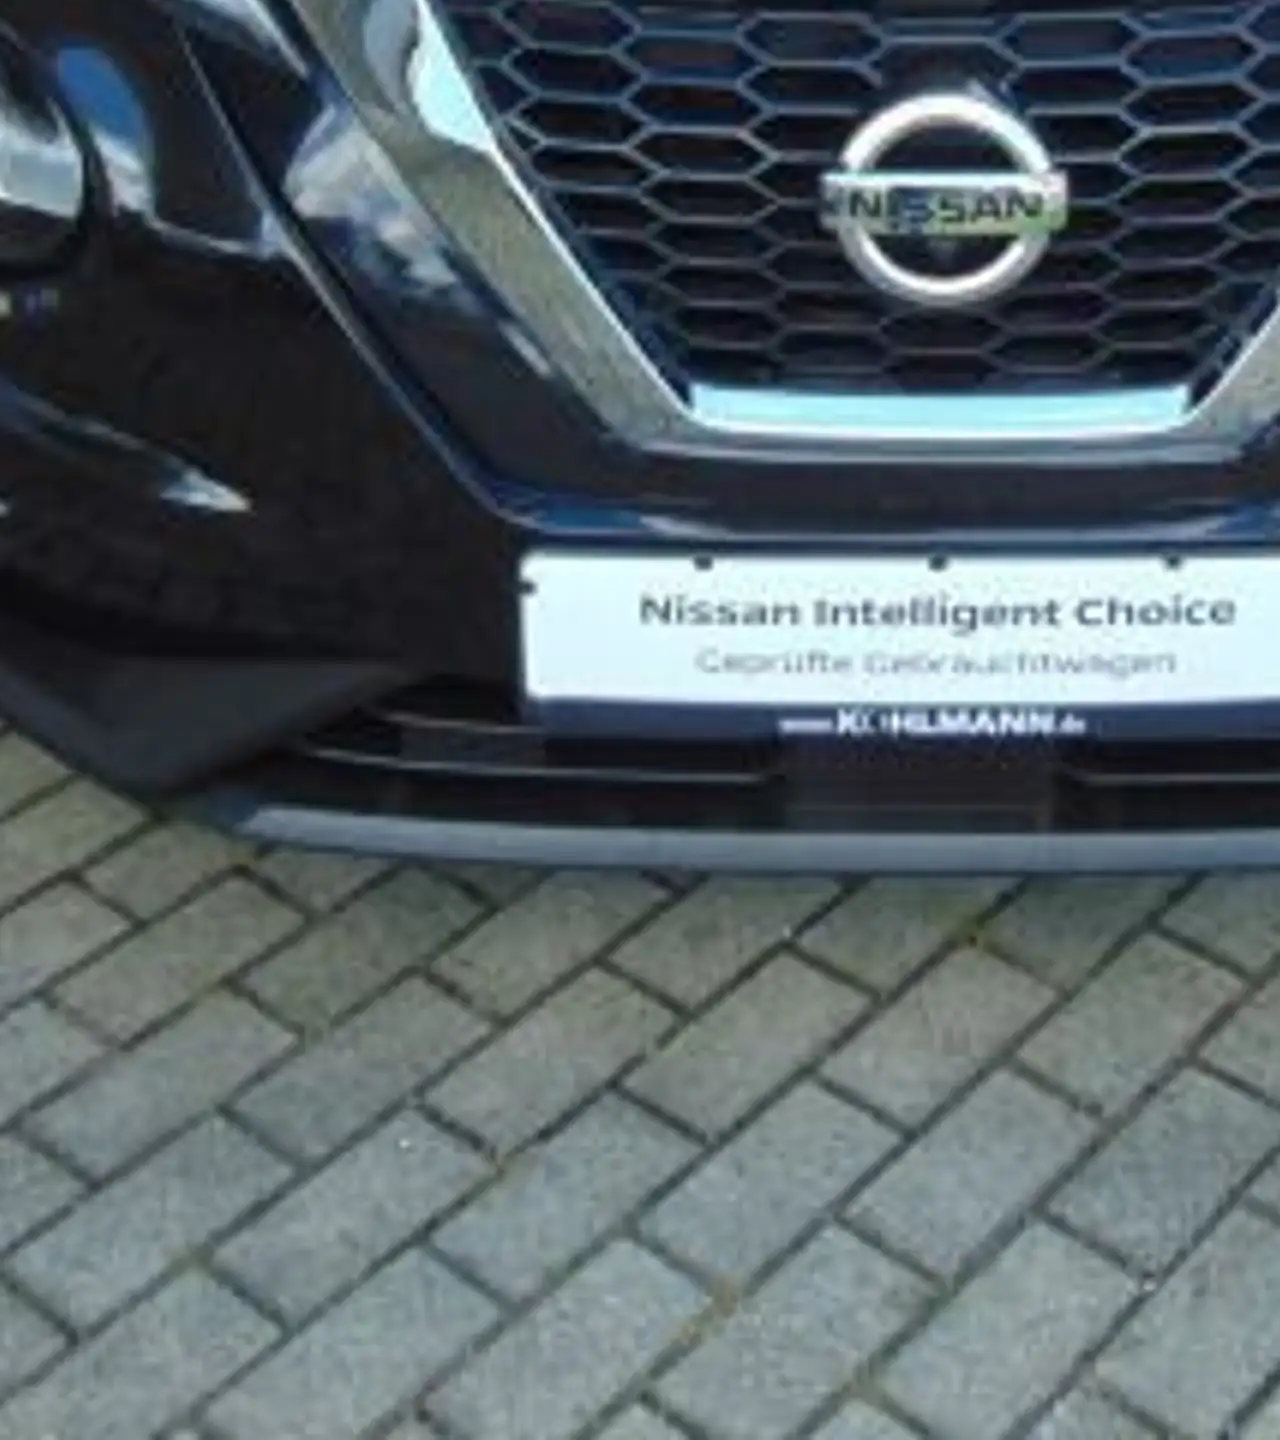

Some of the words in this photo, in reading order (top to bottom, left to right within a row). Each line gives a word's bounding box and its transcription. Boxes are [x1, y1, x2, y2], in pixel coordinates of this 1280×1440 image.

[847, 187, 1044, 223] NISSAN
[639, 593, 801, 627] Nissan
[814, 593, 1061, 636] Intelligent
[1074, 593, 1237, 627] Choice
[694, 646, 855, 680] Geprüfte
